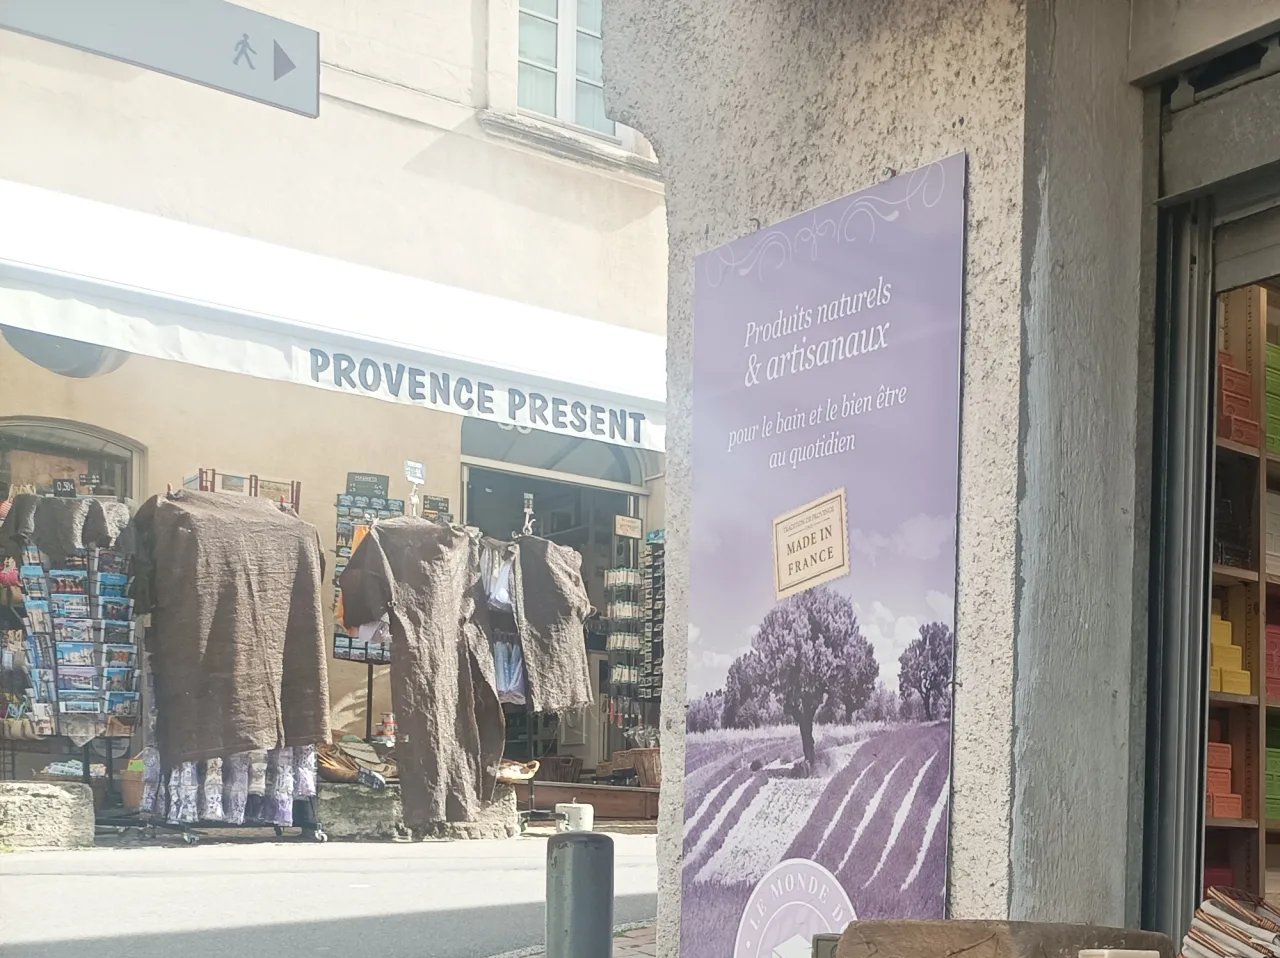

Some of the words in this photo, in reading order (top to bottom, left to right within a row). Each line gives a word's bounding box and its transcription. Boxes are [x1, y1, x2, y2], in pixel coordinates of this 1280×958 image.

[744, 304, 812, 348] Produits
[816, 276, 892, 326] naturels
[744, 353, 762, 387] &
[766, 322, 890, 381] artisanaux
[309, 348, 495, 414] PROVENCE
[507, 387, 646, 444] PRESENT
[728, 421, 759, 452] pour
[761, 413, 772, 437] le
[775, 400, 806, 433] bain
[809, 403, 823, 426] et
[825, 397, 838, 423] le
[841, 388, 872, 418] bien
[876, 383, 907, 409] être
[768, 449, 786, 469] au
[789, 431, 855, 470] quotidien
[786, 531, 818, 556] MADE
[820, 525, 833, 542] IN
[788, 546, 834, 576] FRANCE
[749, 898, 768, 931] LE
[770, 872, 830, 905] MONDE
